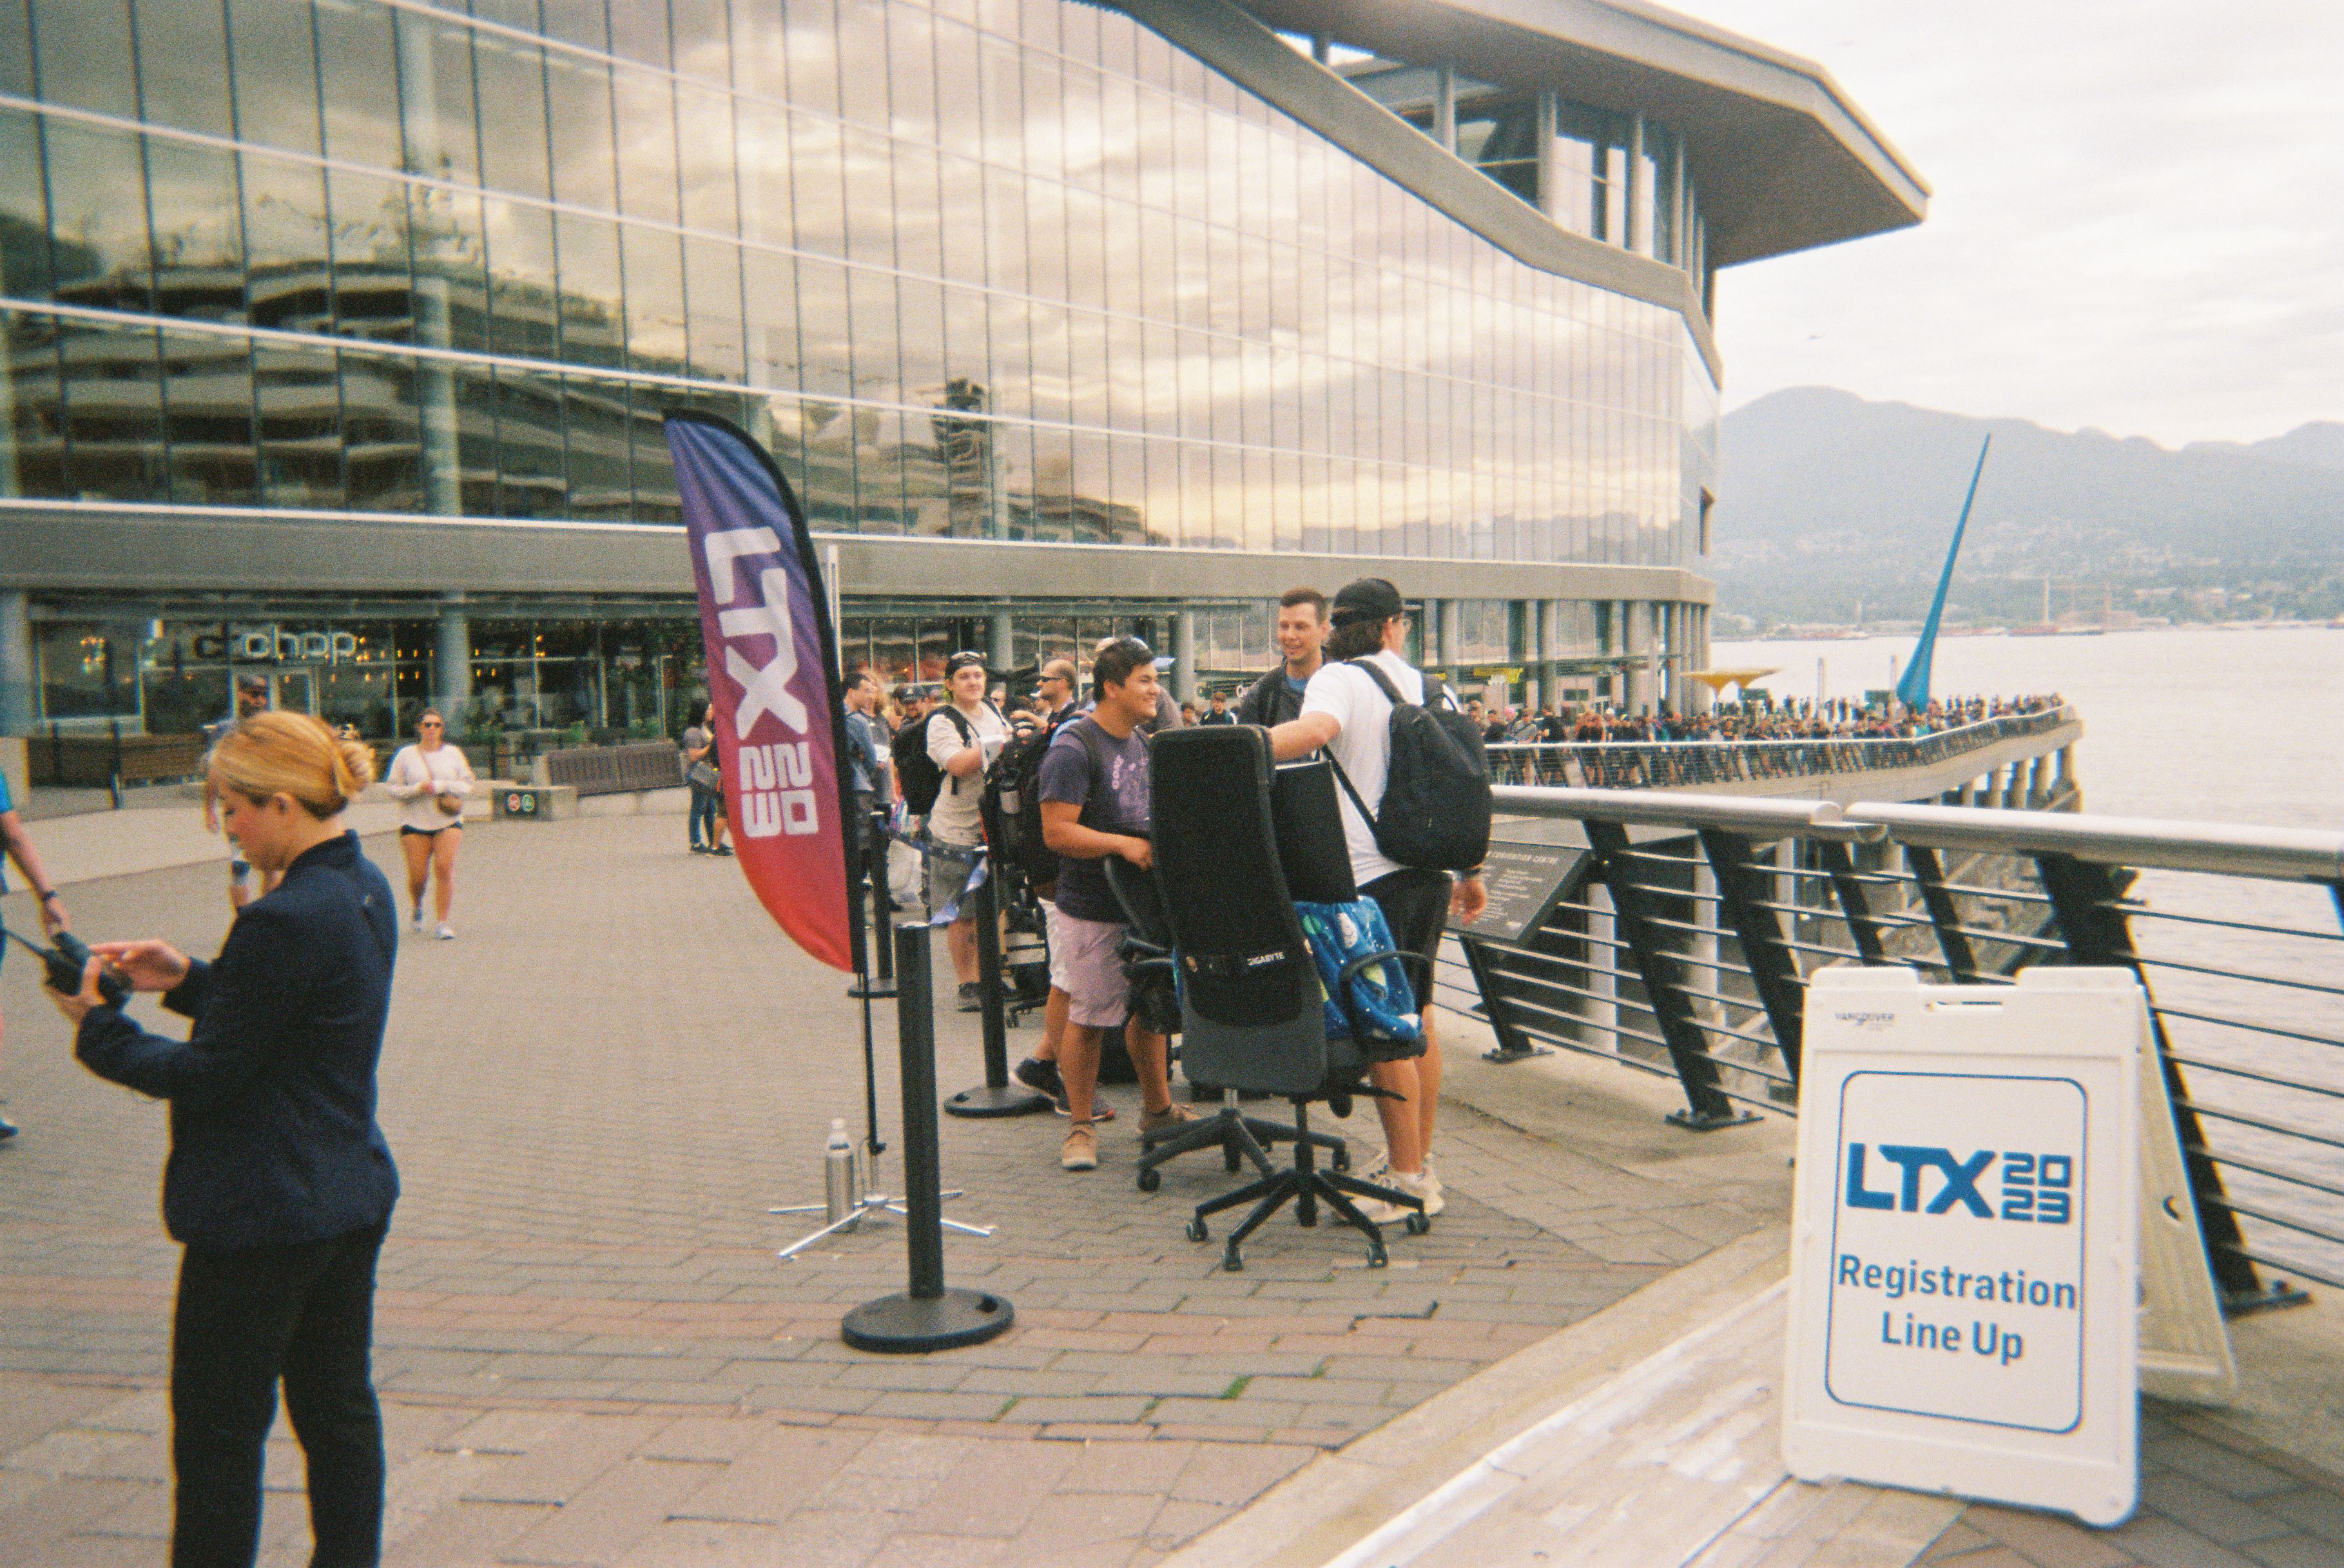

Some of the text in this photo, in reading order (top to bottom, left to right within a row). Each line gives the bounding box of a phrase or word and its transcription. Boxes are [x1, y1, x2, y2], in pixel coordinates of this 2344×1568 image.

[706, 527, 808, 740] LTX
[1846, 1143, 2071, 1219] LTX 20
[2000, 1187, 2071, 1224] 23
[1837, 1253, 2076, 1310] Registration
[1882, 1310, 2024, 1366] Line Up
